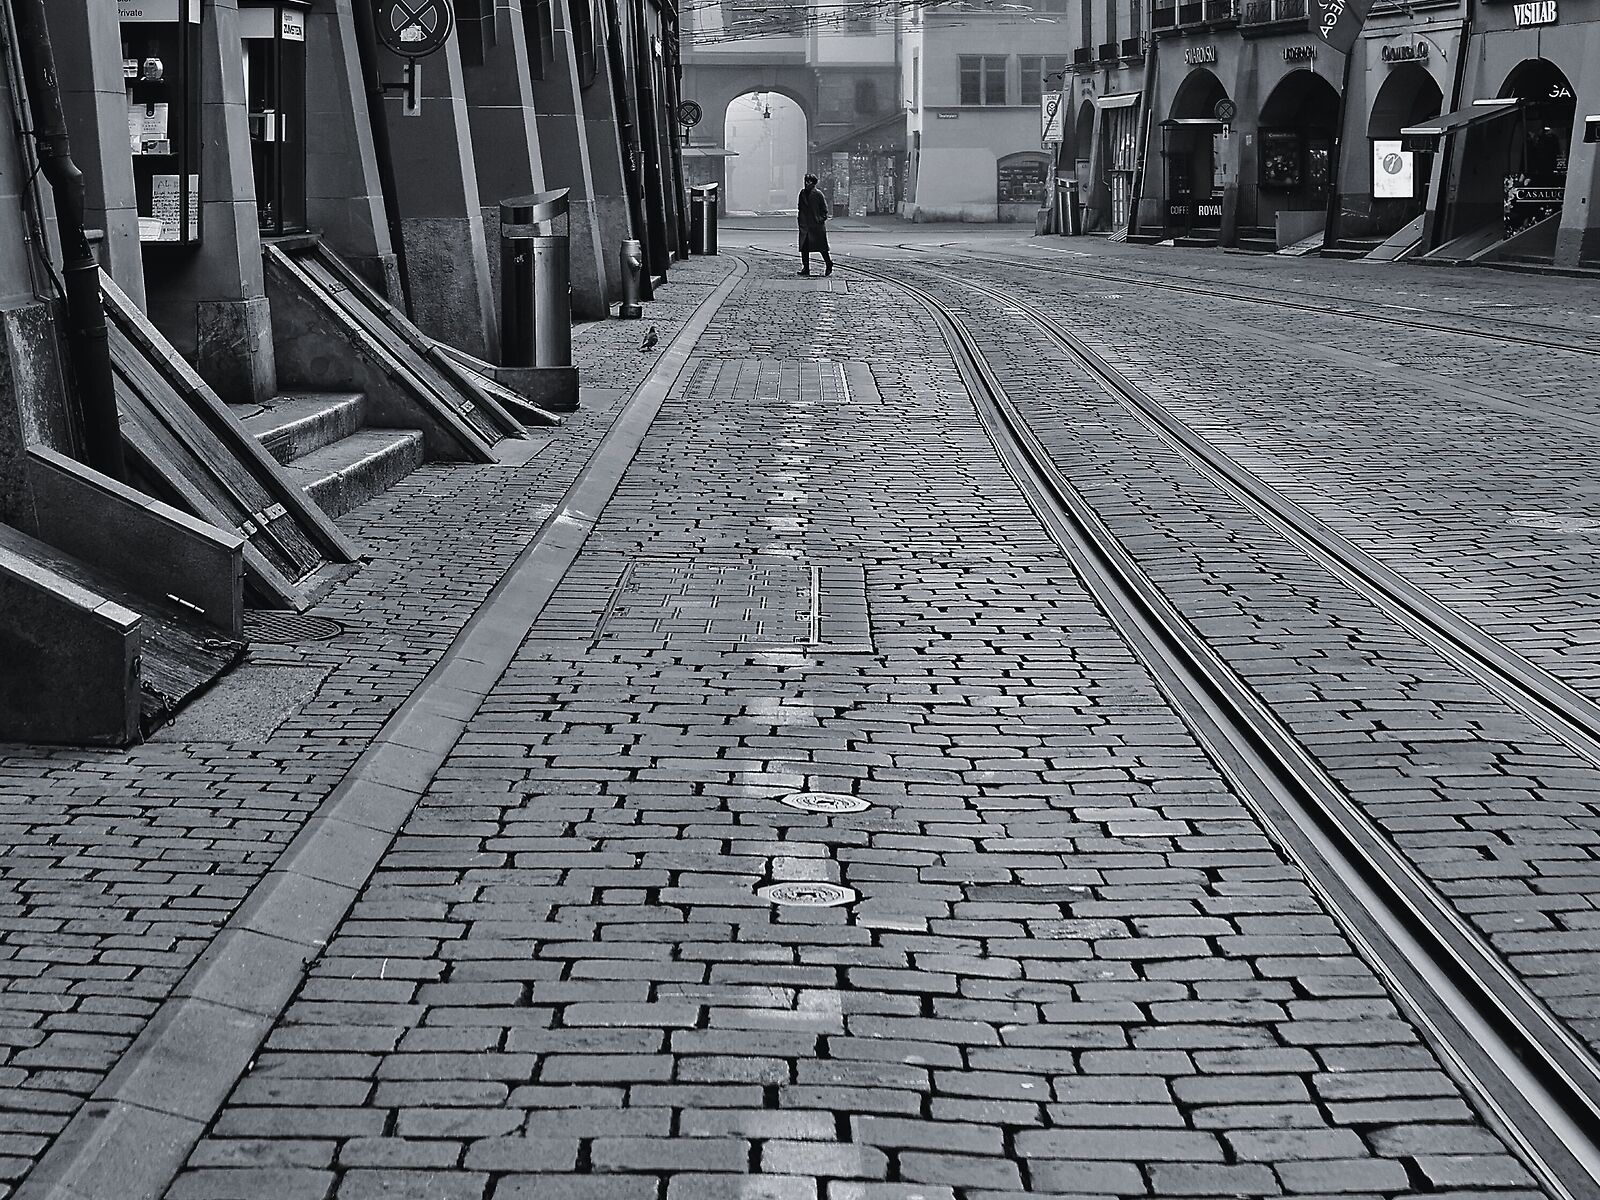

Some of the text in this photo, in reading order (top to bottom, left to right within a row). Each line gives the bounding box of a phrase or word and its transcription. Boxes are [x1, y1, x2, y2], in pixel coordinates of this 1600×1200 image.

[1513, 0, 1558, 26] VISILAB
[1184, 45, 1216, 64] SWAROVSKI
[1198, 205, 1223, 216] ROYAL
